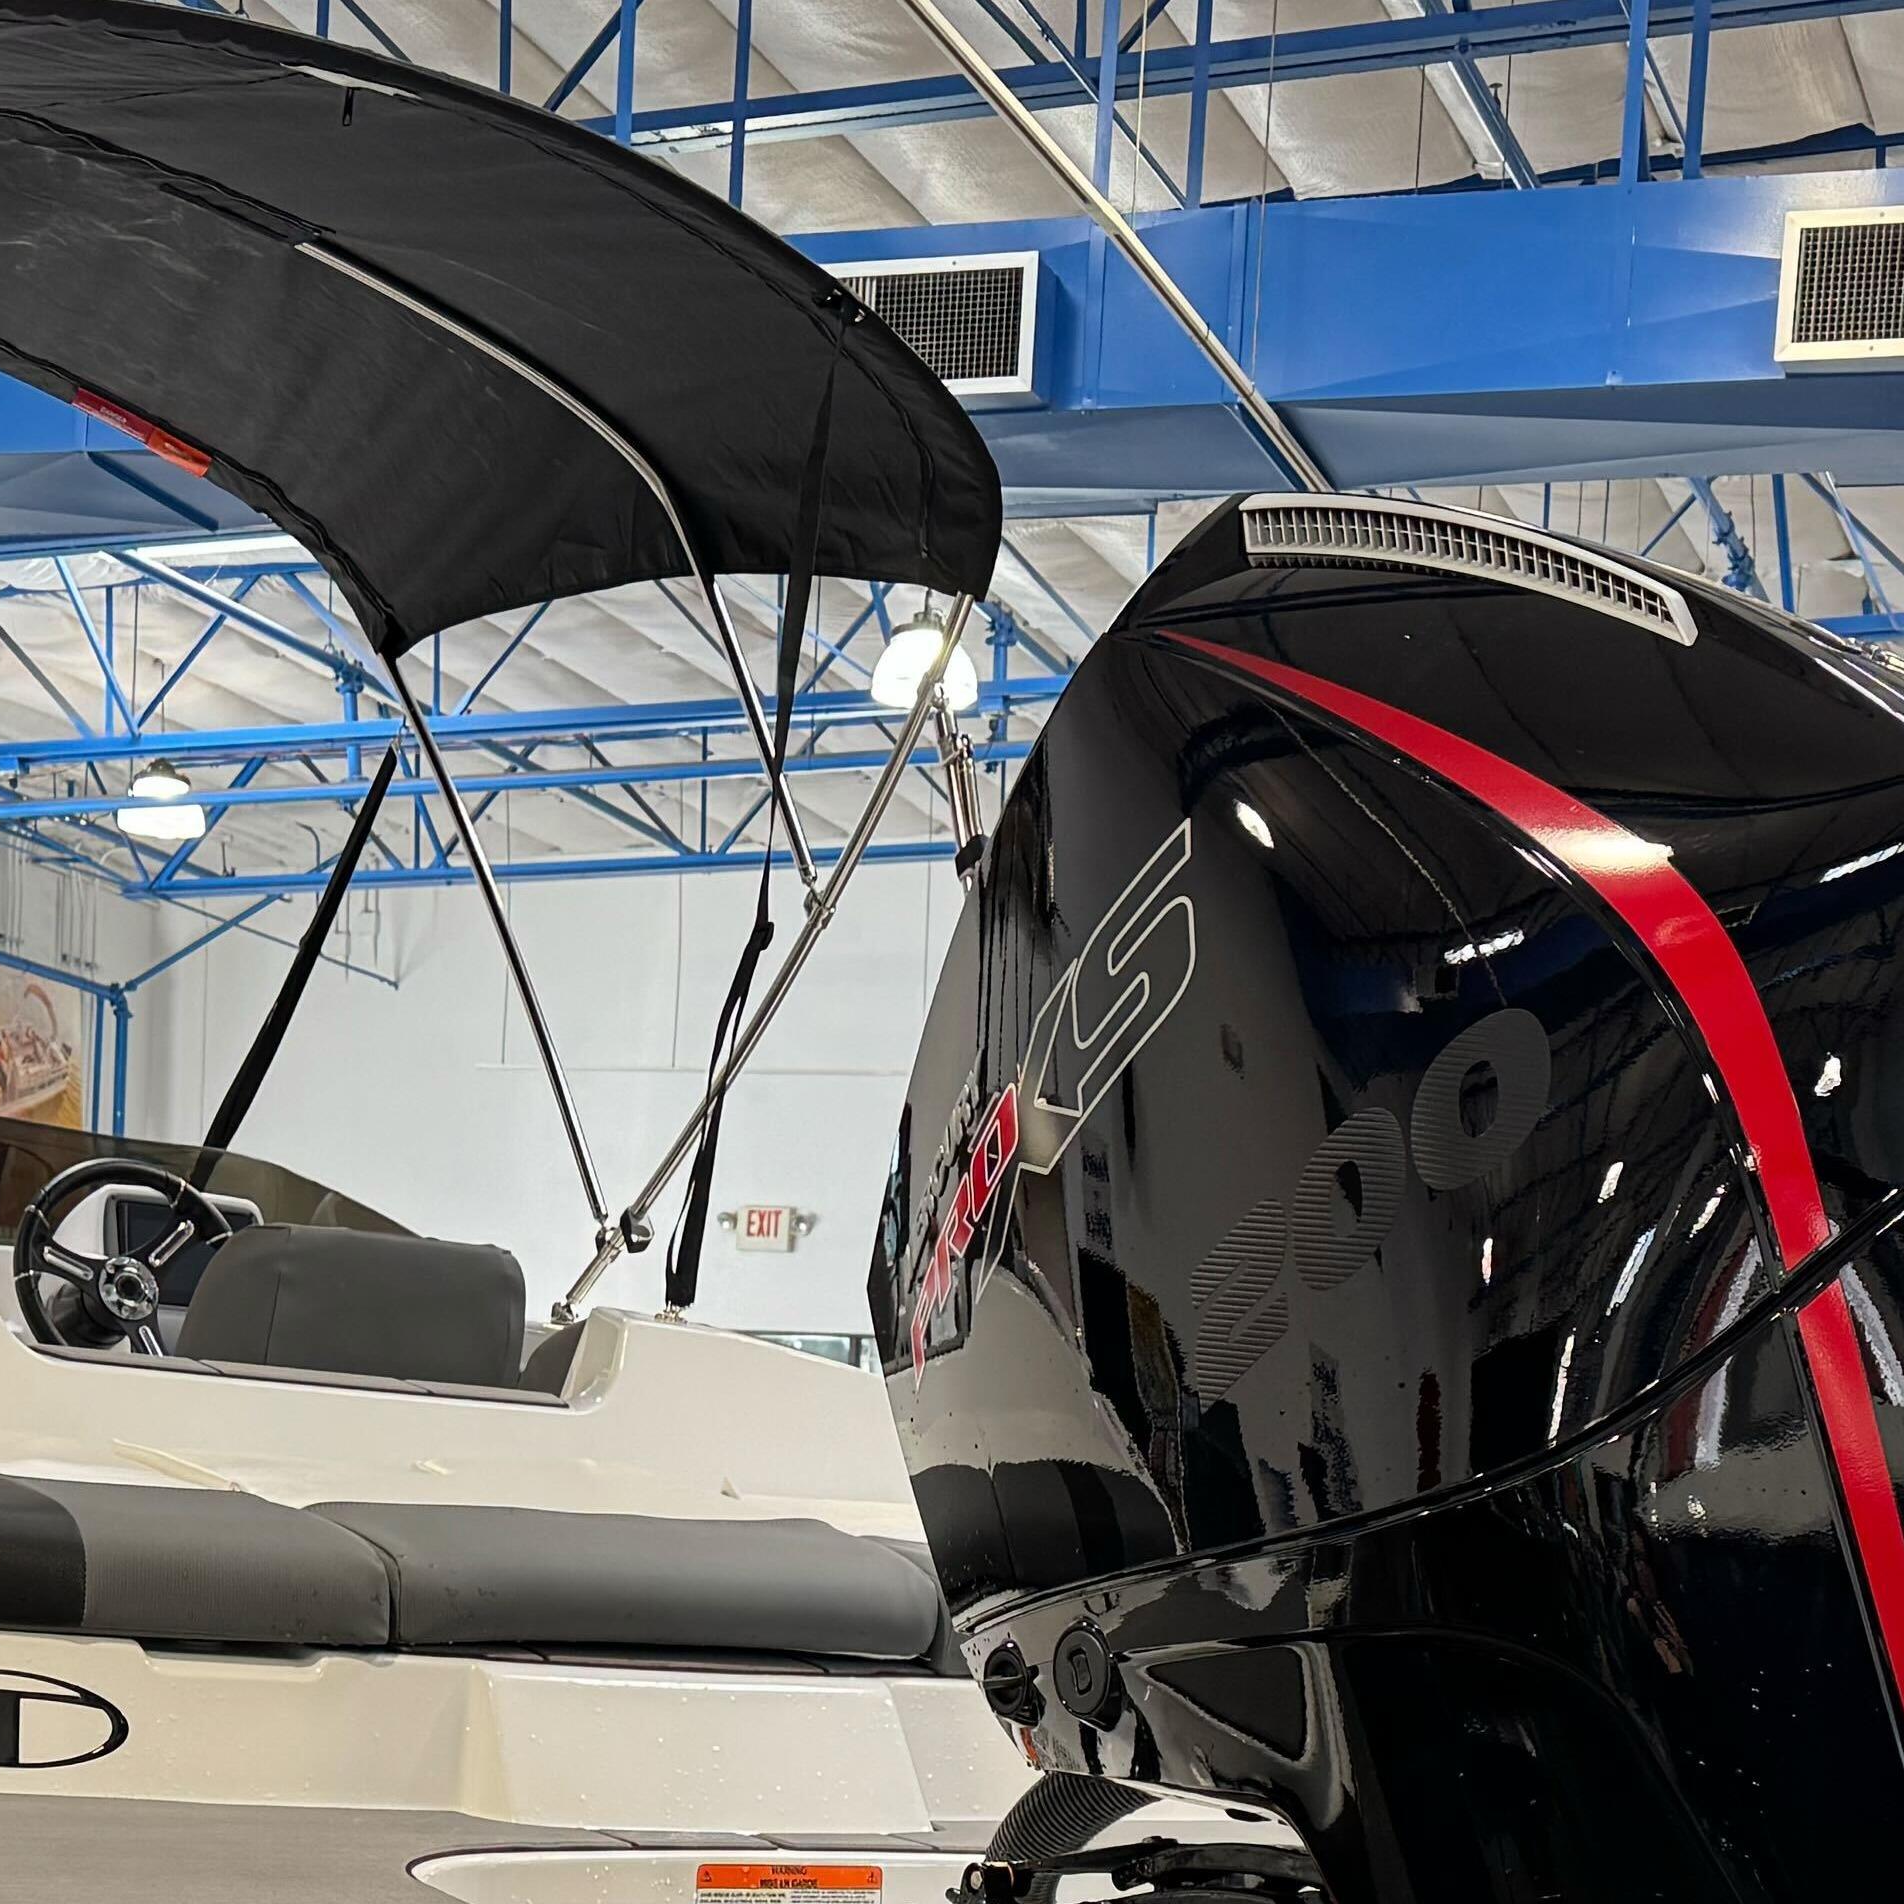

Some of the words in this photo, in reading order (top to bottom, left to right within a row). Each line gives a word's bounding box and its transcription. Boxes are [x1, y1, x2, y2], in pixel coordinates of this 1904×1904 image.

[745, 1209, 783, 1239] EXIT
[911, 1082, 1019, 1396] PRO
[1189, 1007, 1552, 1412] 200
